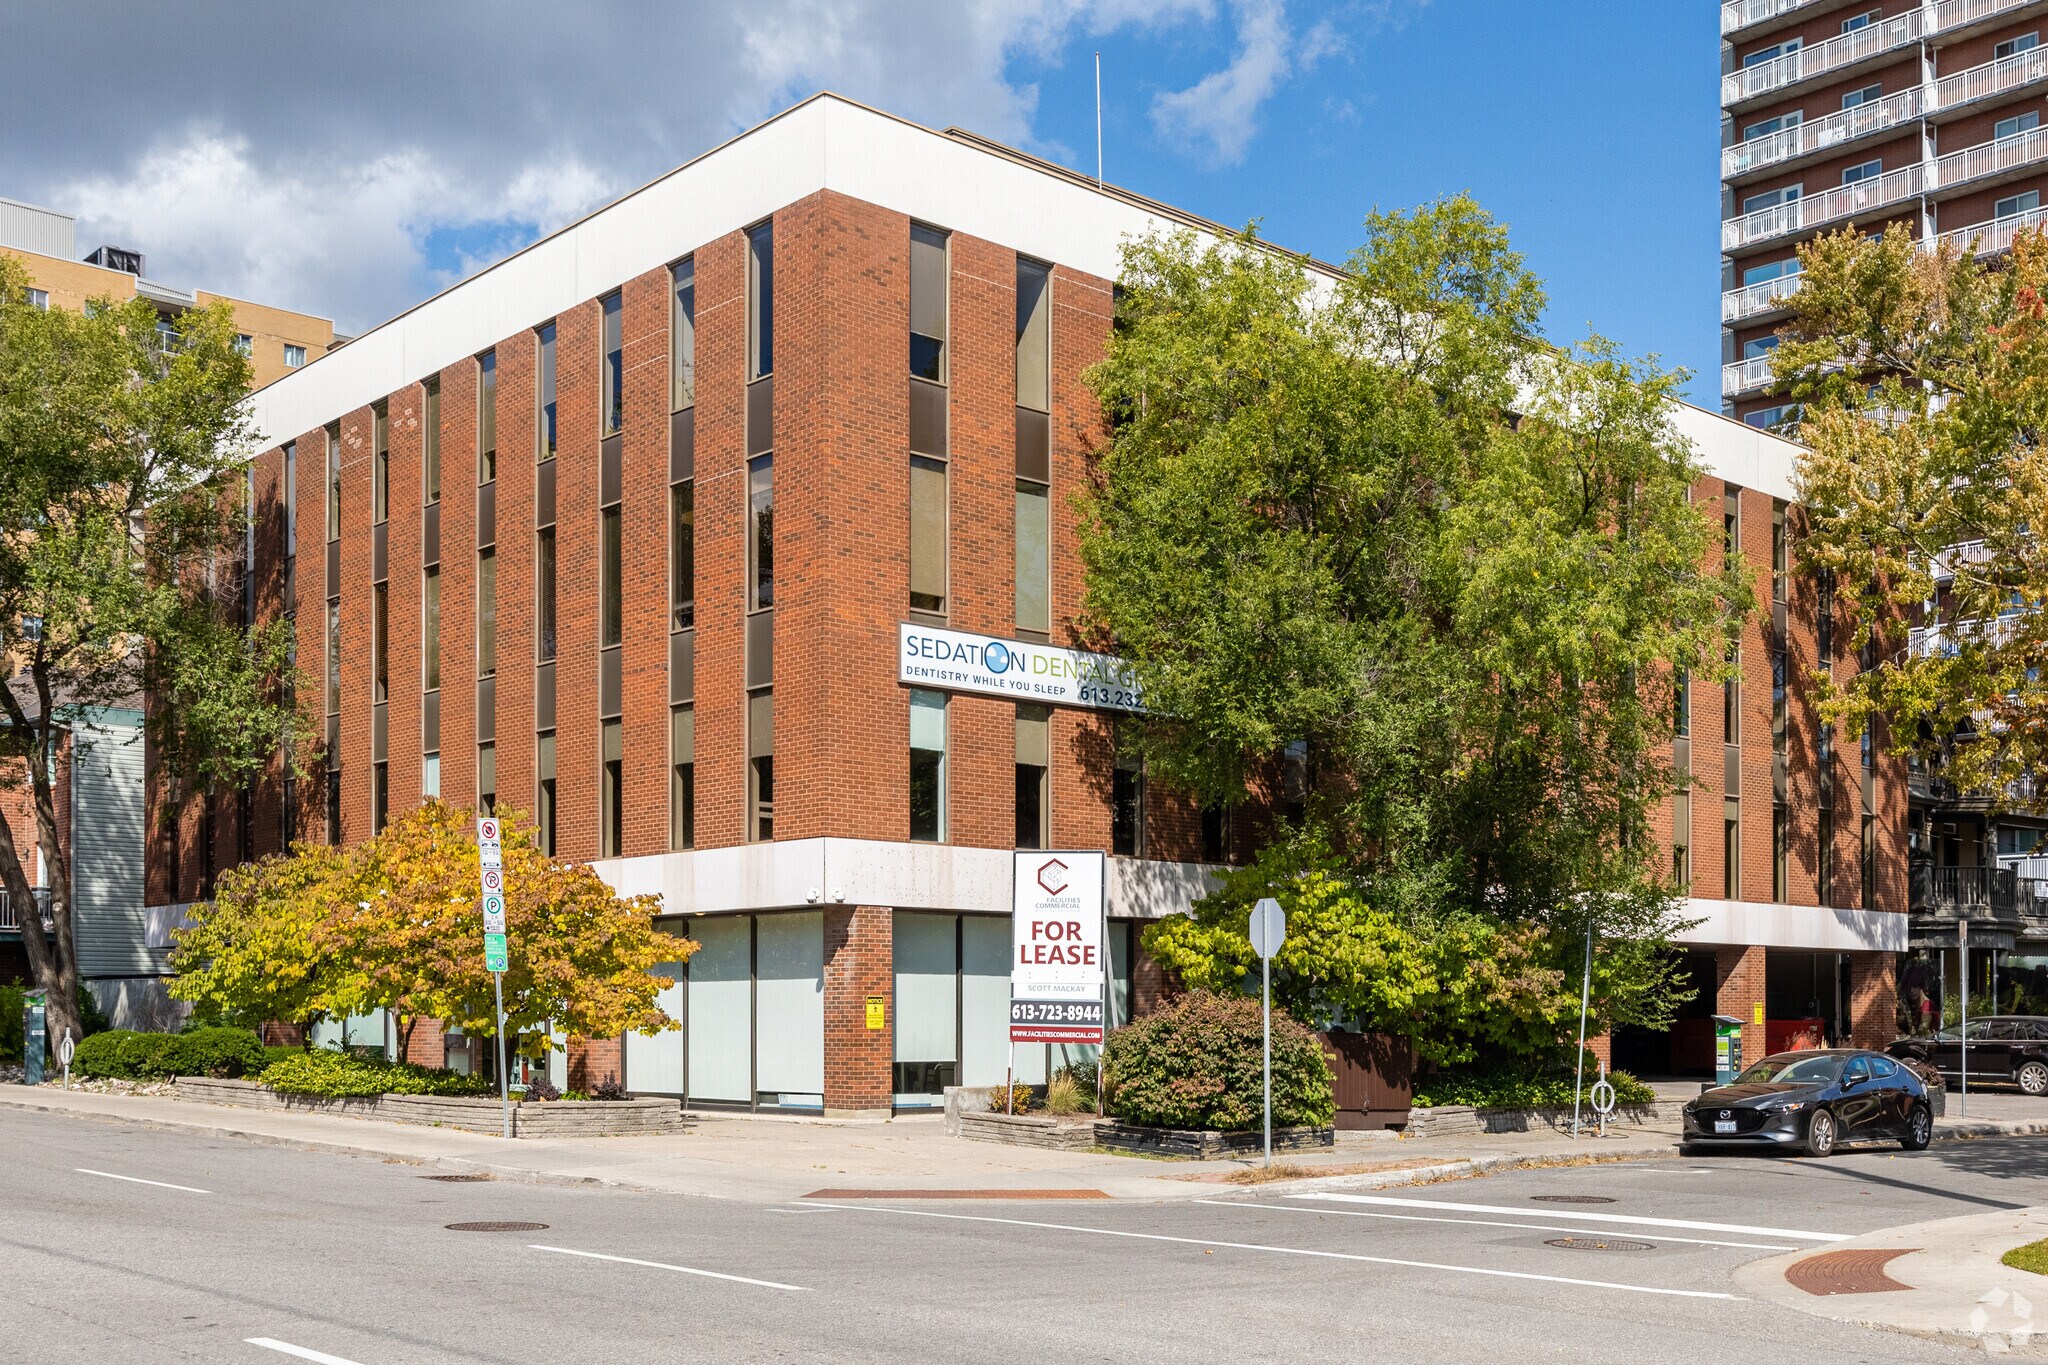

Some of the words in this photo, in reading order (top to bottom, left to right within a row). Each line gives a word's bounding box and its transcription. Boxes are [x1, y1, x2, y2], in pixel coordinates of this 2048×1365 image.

[907, 636, 1026, 674] SEDATION
[1033, 655, 1114, 685] DENTAL
[906, 666, 969, 682] DENTISTRY
[973, 674, 1005, 688] WHILE
[1009, 680, 1030, 691] YOU
[1034, 683, 1066, 696] SLEEP
[1032, 921, 1082, 941] FOR
[1021, 945, 1095, 965] LEASE
[1053, 985, 1086, 993] MACKAY
[1012, 1004, 1100, 1021] 613-723-8944
[1012, 1030, 1100, 1039] WWW.FACILITIESCOMMERCIAL.COM
